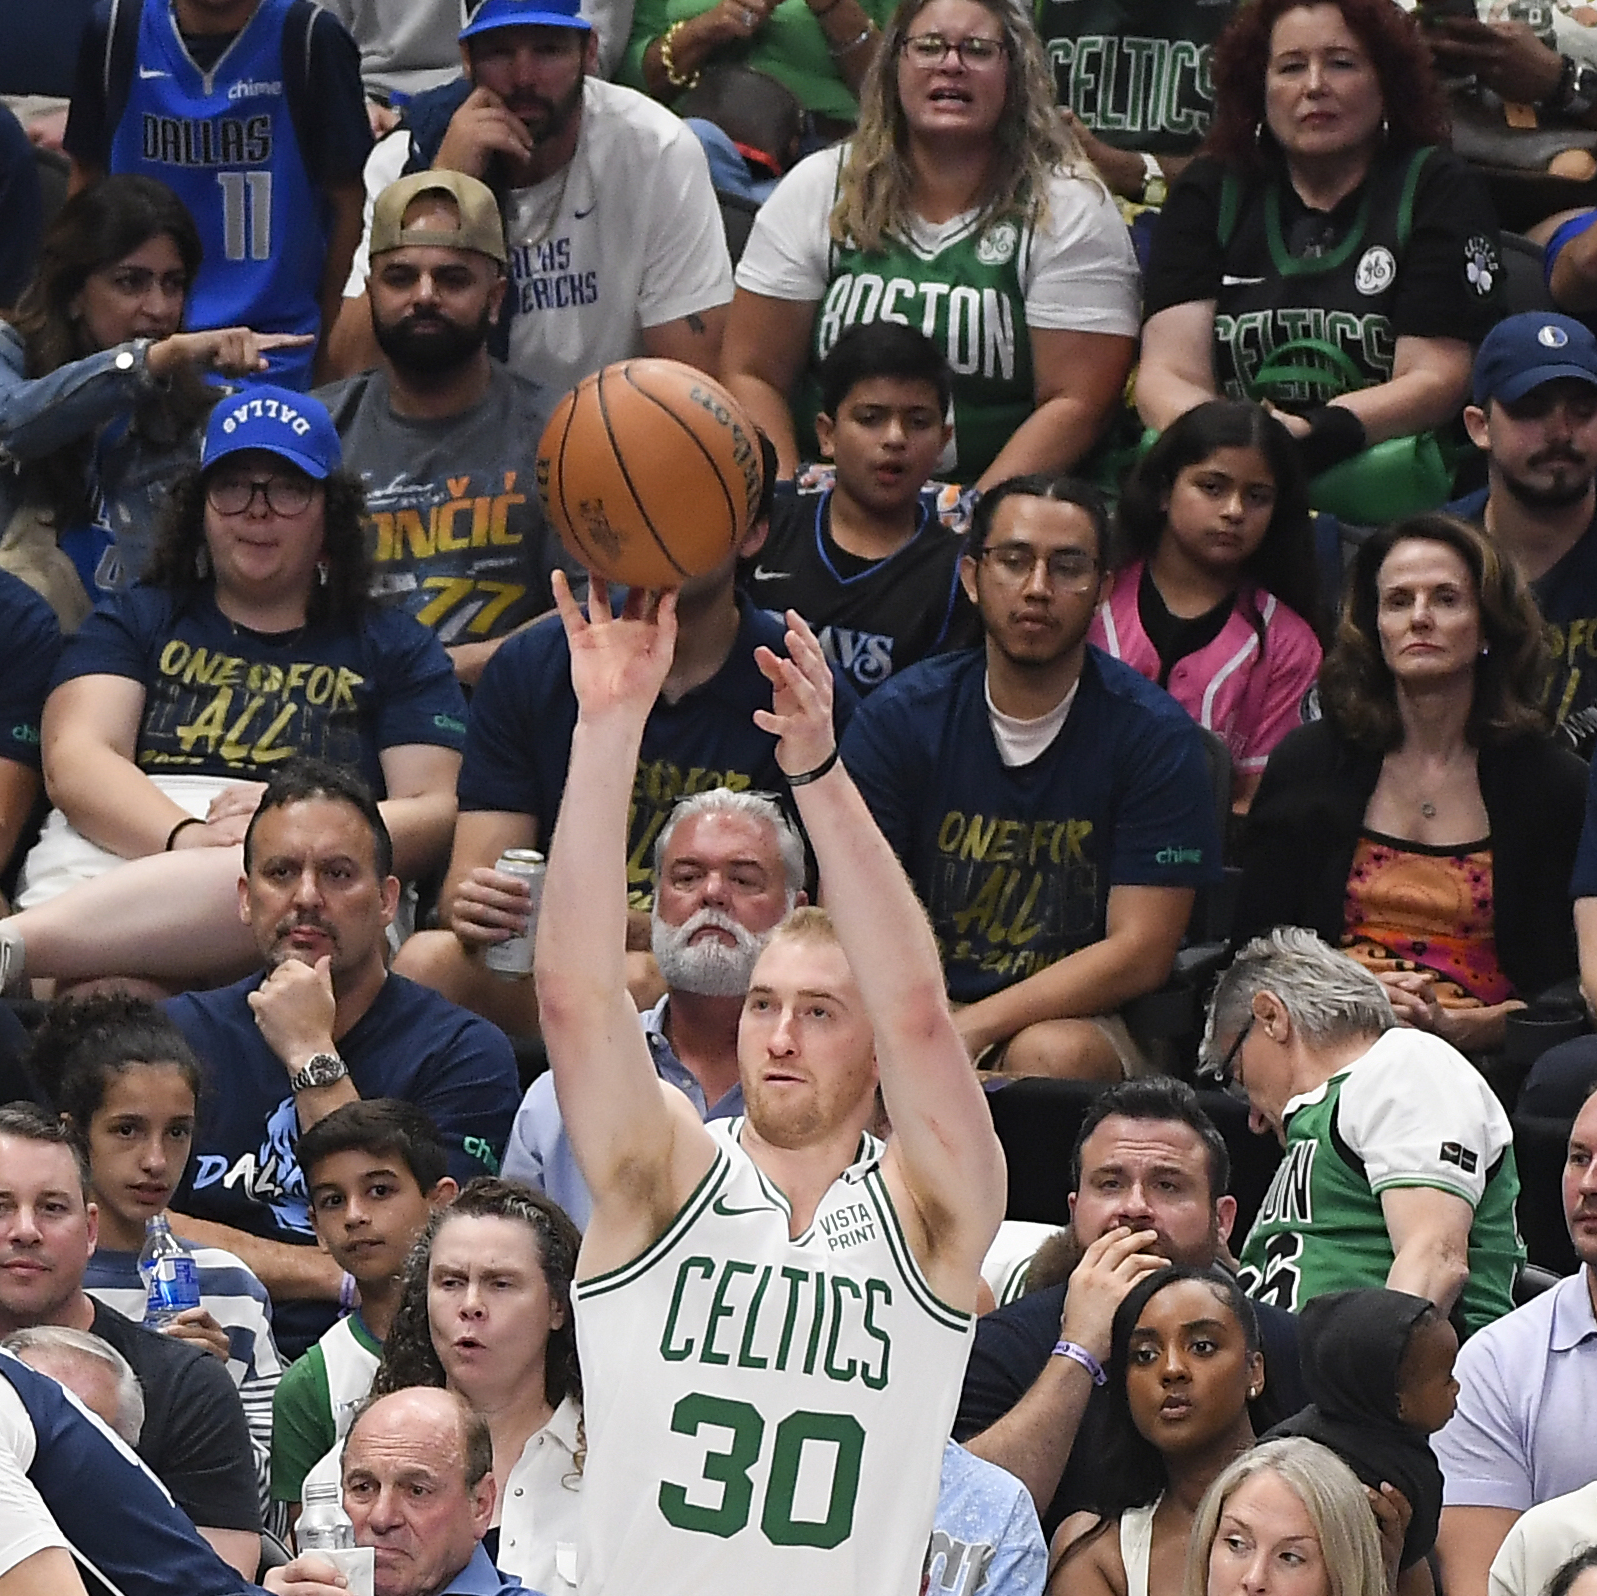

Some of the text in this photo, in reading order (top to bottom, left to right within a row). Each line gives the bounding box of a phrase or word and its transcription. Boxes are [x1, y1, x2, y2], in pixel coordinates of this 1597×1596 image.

[227, 78, 283, 100] chime
[141, 113, 273, 167] DALLAS
[216, 170, 274, 261] 11
[817, 272, 1016, 380] BOSTON
[222, 399, 311, 436] DALLAS
[159, 638, 366, 711] ONE FOR
[176, 694, 300, 763] ALL
[955, 868, 1045, 948] ALL
[818, 1202, 873, 1236] VISTA
[826, 1222, 878, 1252] PRINT
[659, 1254, 893, 1391] CELTICS
[657, 1392, 867, 1550] 30
